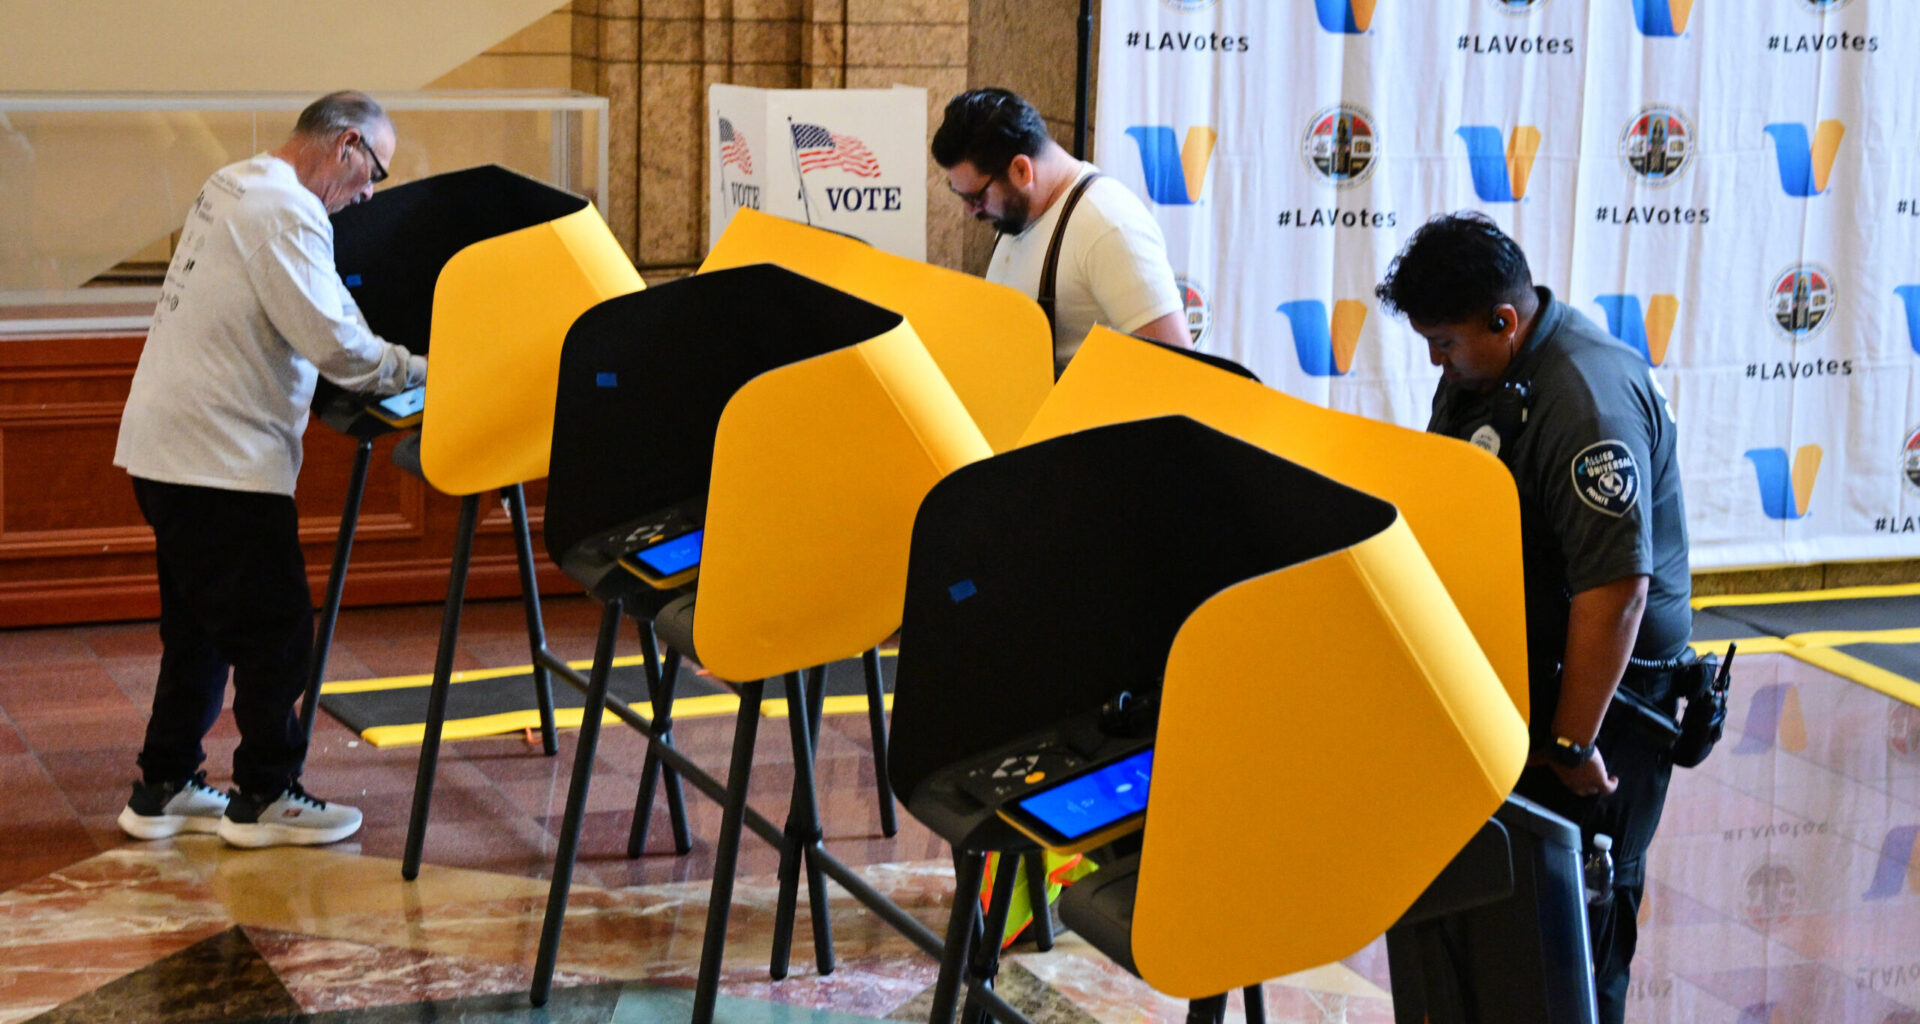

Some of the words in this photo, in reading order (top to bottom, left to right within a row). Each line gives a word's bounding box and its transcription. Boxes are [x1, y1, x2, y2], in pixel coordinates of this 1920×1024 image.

[1126, 31, 1249, 53] #LAVotes
[1457, 34, 1574, 54] #LAVotes
[1767, 31, 1879, 53] #LAVotes
[731, 182, 761, 210] VOTE
[826, 187, 902, 211] VOTE
[1277, 208, 1397, 228] #LAVotes
[1595, 205, 1710, 225] #LAVotes
[1746, 356, 1853, 380] #LAVotes
[1587, 456, 1633, 477] UNIVERSAL
